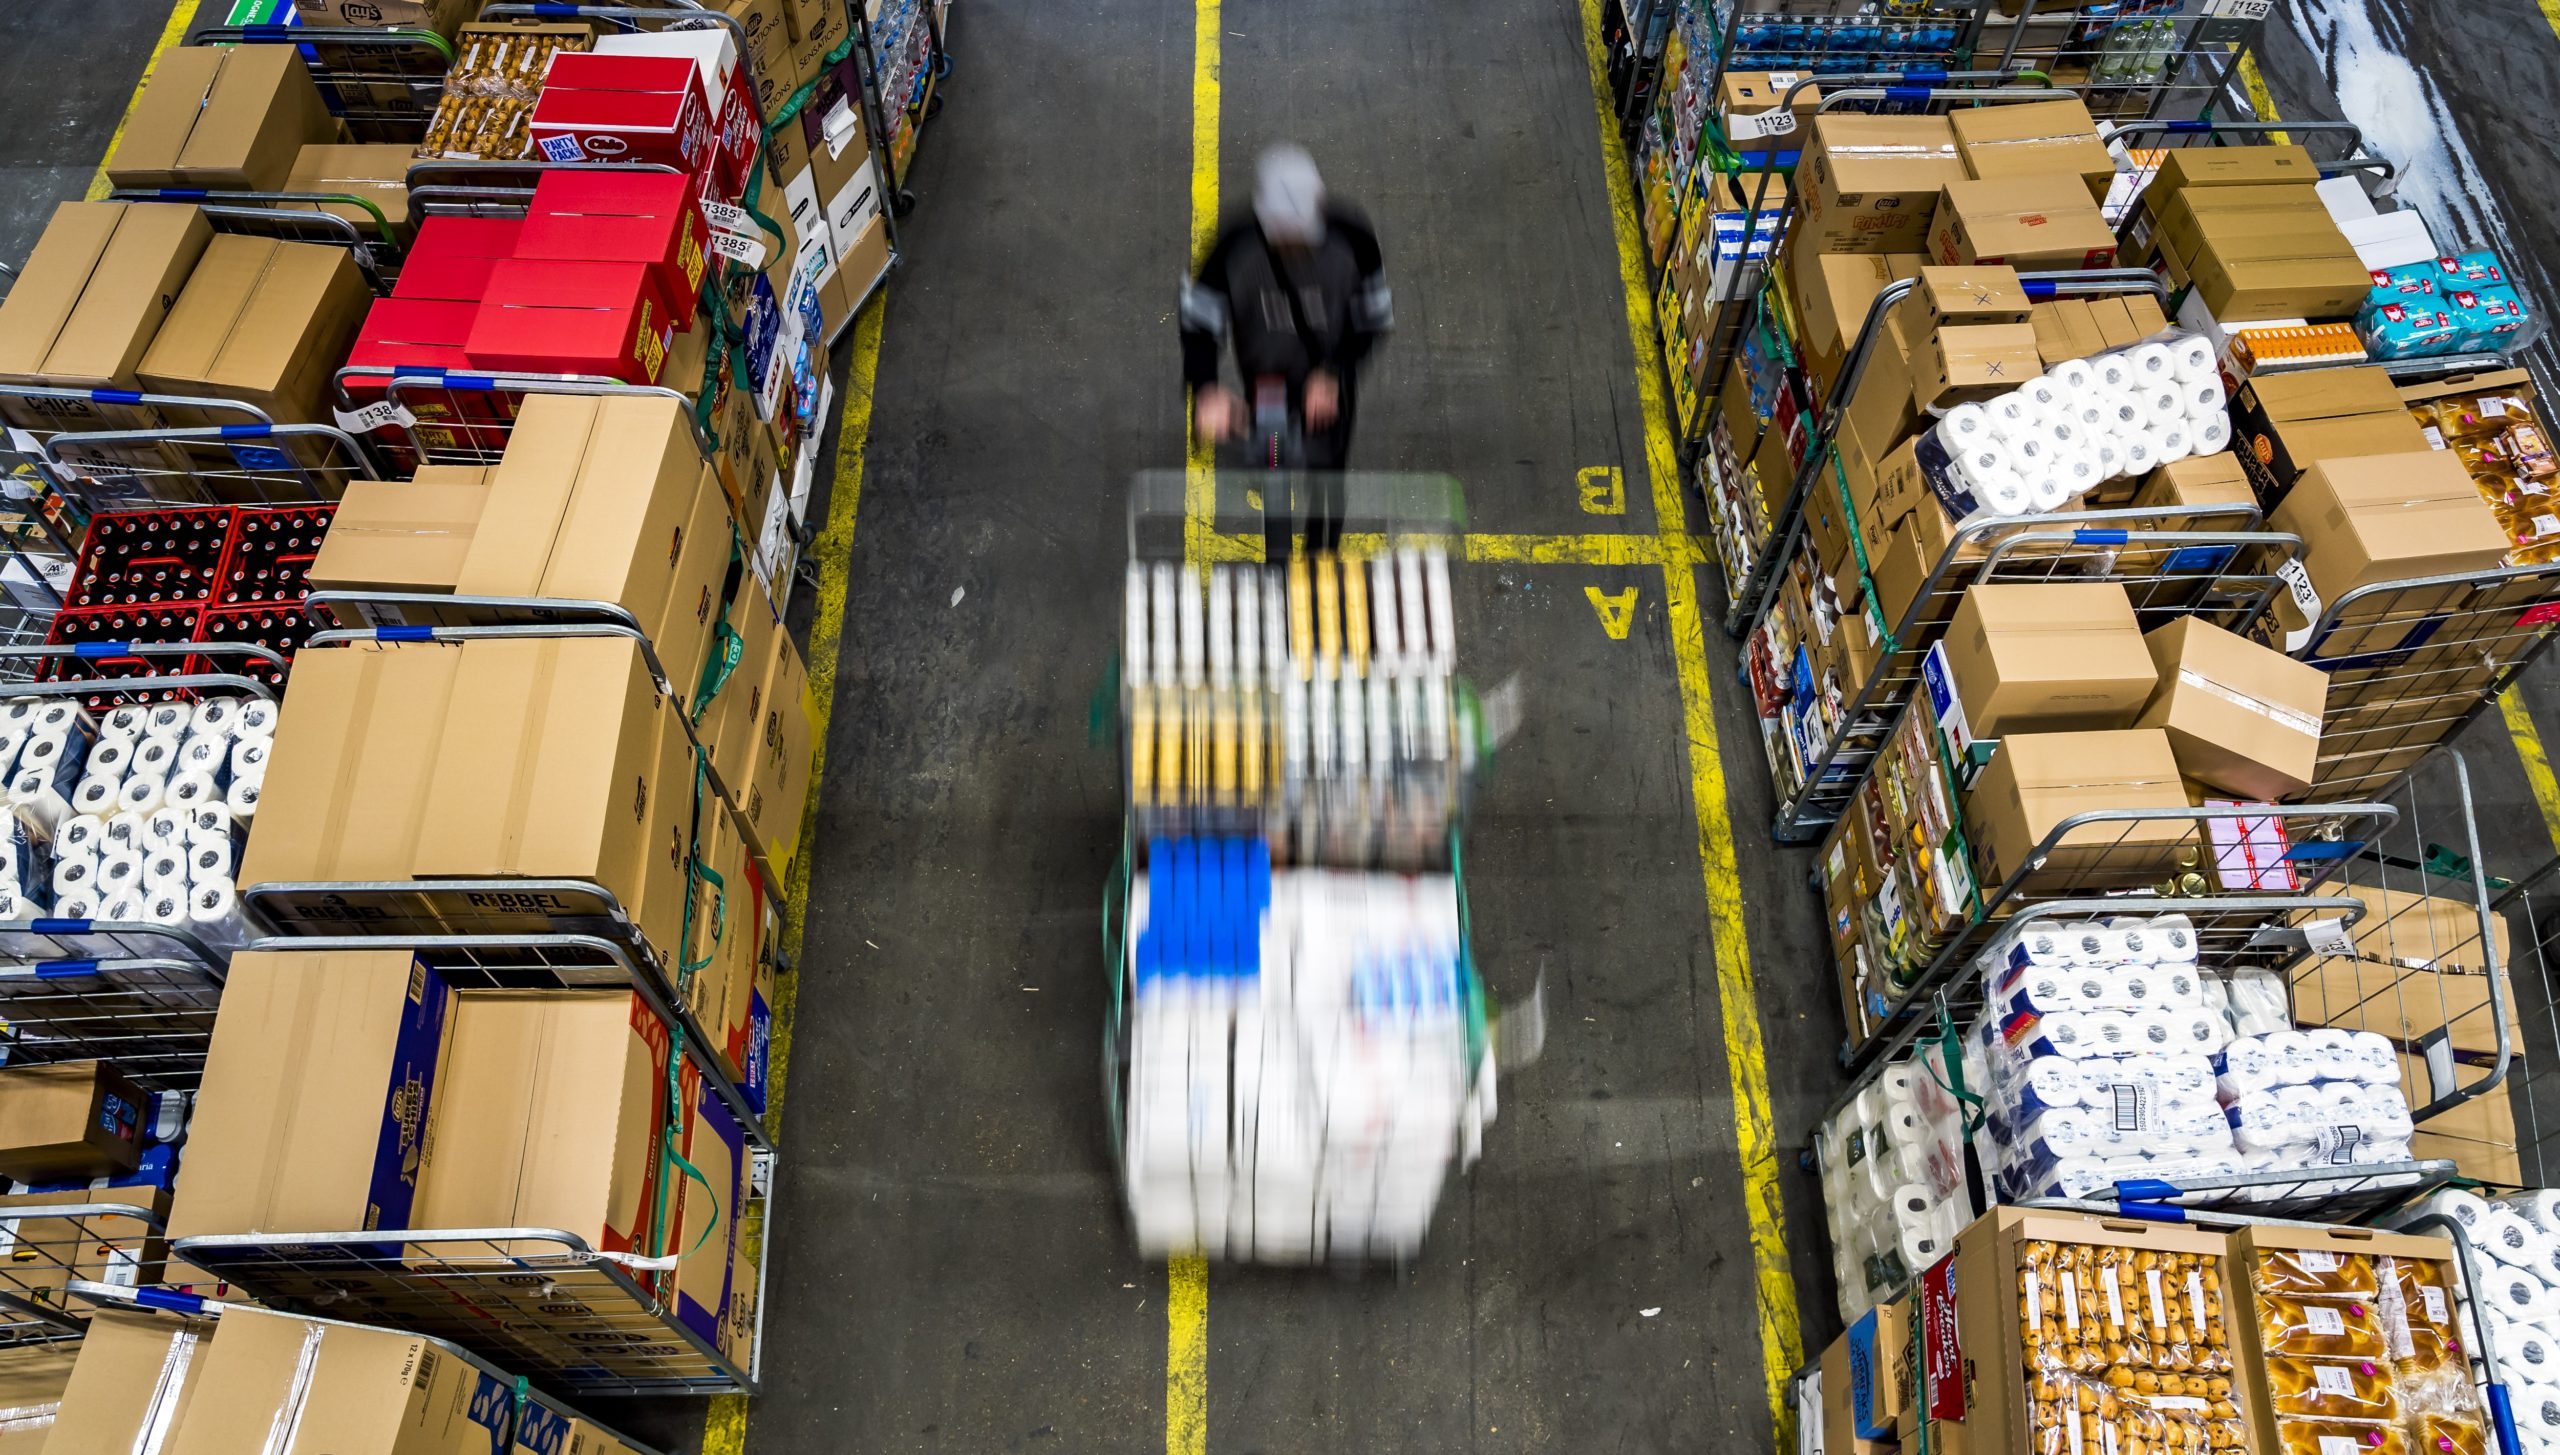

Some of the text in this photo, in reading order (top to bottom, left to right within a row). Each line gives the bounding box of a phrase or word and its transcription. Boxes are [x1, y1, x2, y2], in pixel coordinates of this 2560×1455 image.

[2239, 1, 2268, 13] 1123
[799, 20, 843, 70] SENSATIONS
[1760, 115, 1792, 127] 1123
[542, 134, 577, 152] PARTY
[549, 147, 577, 161] PACK
[702, 202, 737, 218] 1385
[713, 234, 747, 251] 1385
[365, 405, 392, 420] 138
[1577, 466, 1626, 515] B
[2291, 565, 2312, 601] 1123
[1584, 587, 1639, 640] A
[468, 892, 570, 909] RIBBEL
[401, 1080, 414, 1147] SUPER
[408, 1080, 420, 1140] CHIPS
[647, 1134, 657, 1180] Naturel
[1936, 1289, 1951, 1378] Breakers
[1945, 1303, 1957, 1369] Heart
[410, 1344, 418, 1353] 12
[403, 1360, 414, 1377] 170g
